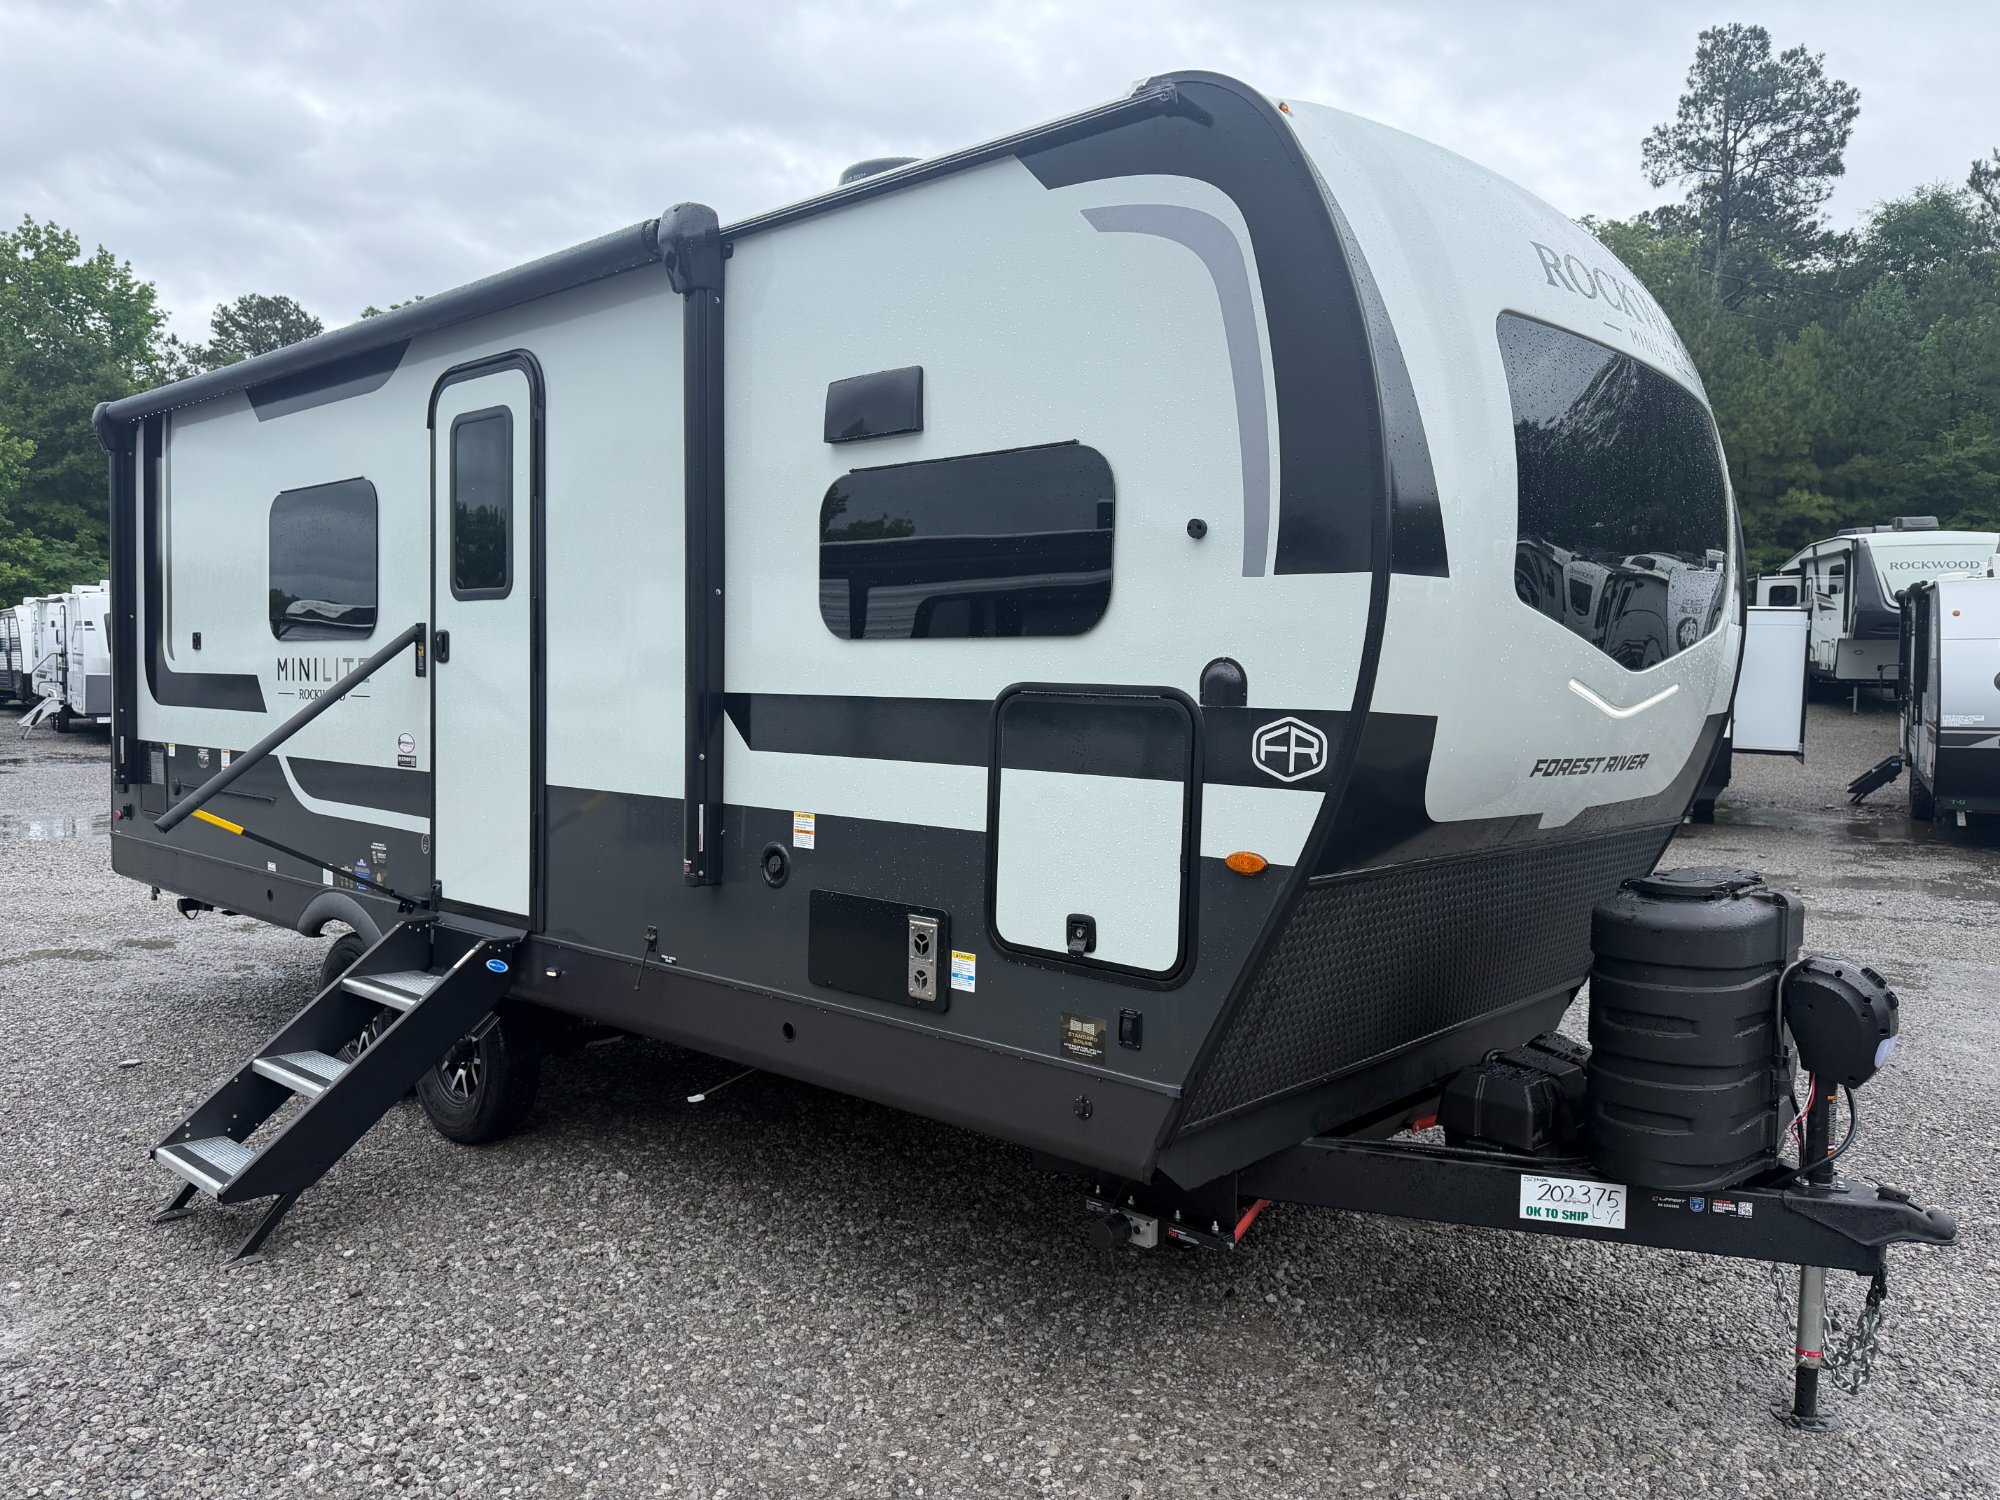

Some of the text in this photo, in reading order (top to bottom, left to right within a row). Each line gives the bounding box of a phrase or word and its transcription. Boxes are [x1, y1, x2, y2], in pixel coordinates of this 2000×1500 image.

[1889, 560, 1980, 570] ROCKWOOD
[1529, 753, 1650, 777] FOREST RIVER
[1067, 1031, 1099, 1042] STANDARD
[1073, 1038, 1093, 1047] SOLAR
[1536, 1183, 1622, 1208] 202375
[1525, 1205, 1589, 1221] OK TO SHIP
